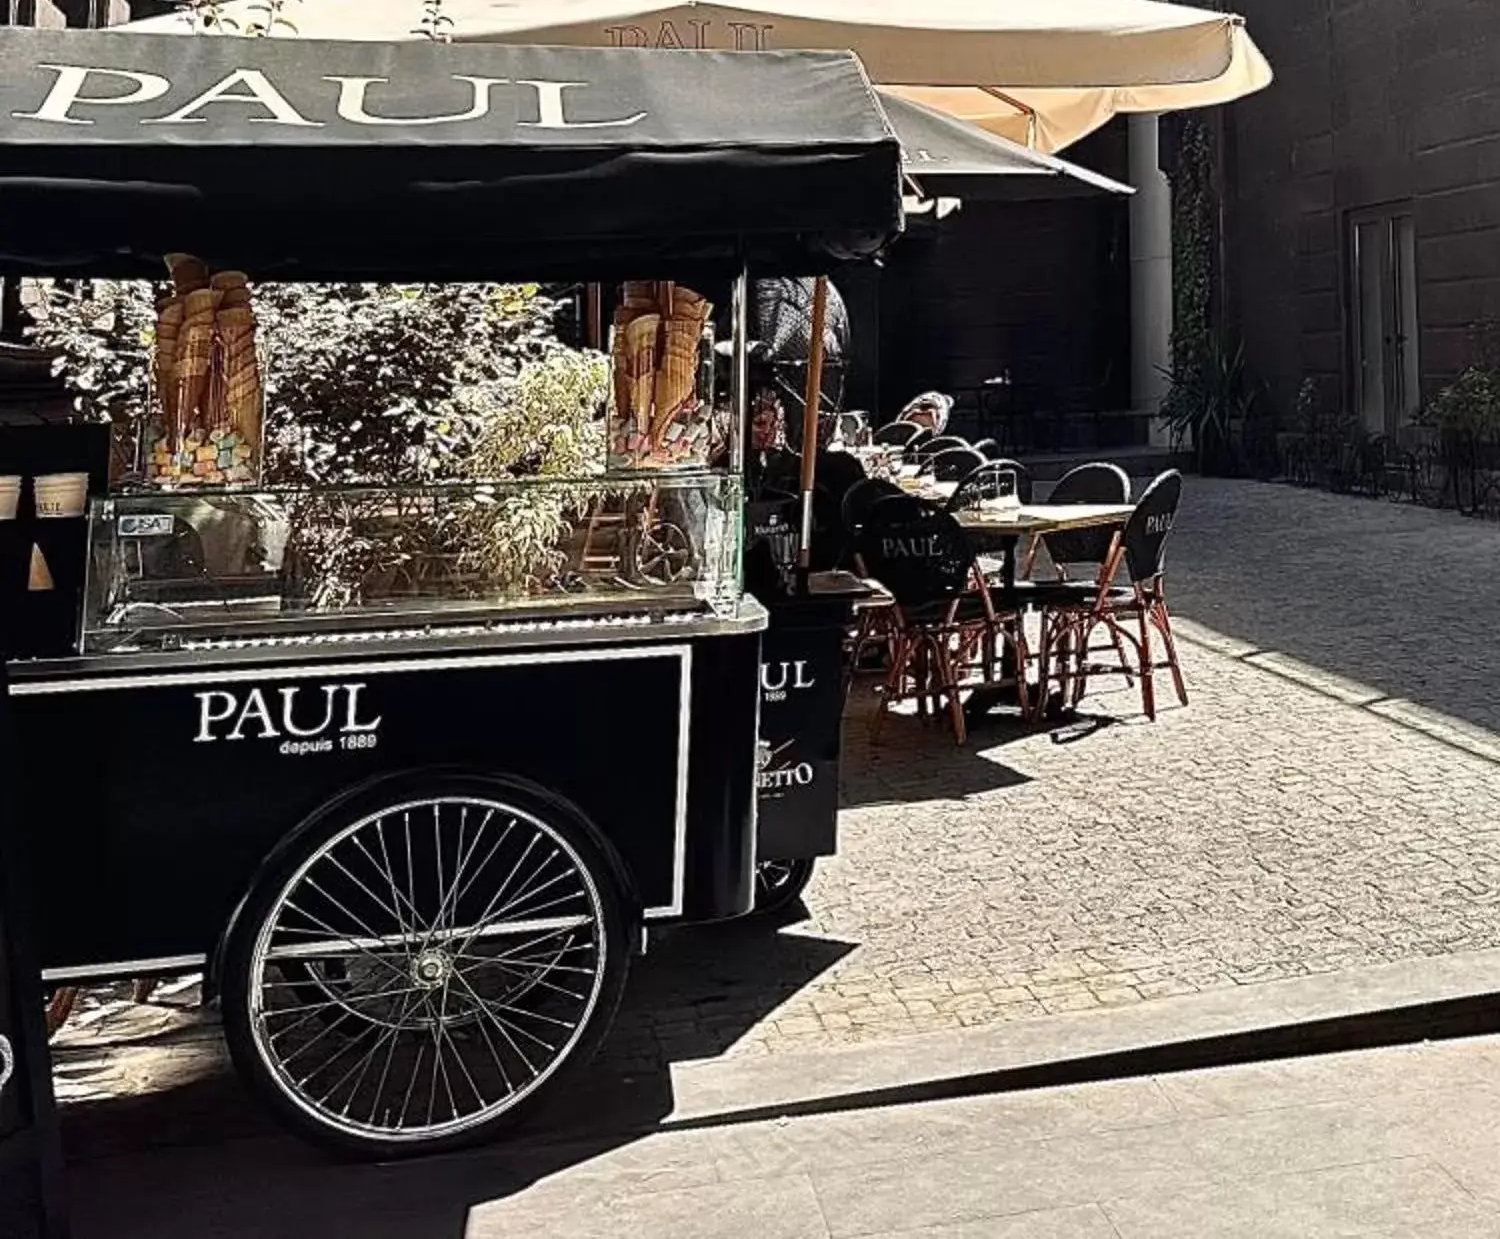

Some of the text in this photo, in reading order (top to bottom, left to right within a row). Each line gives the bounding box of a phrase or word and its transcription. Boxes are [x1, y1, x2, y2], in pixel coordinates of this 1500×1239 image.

[12, 63, 647, 128] PAUL
[882, 538, 943, 558] PAUL
[193, 683, 381, 742] PAUL
[280, 734, 377, 756] depuis 1889
